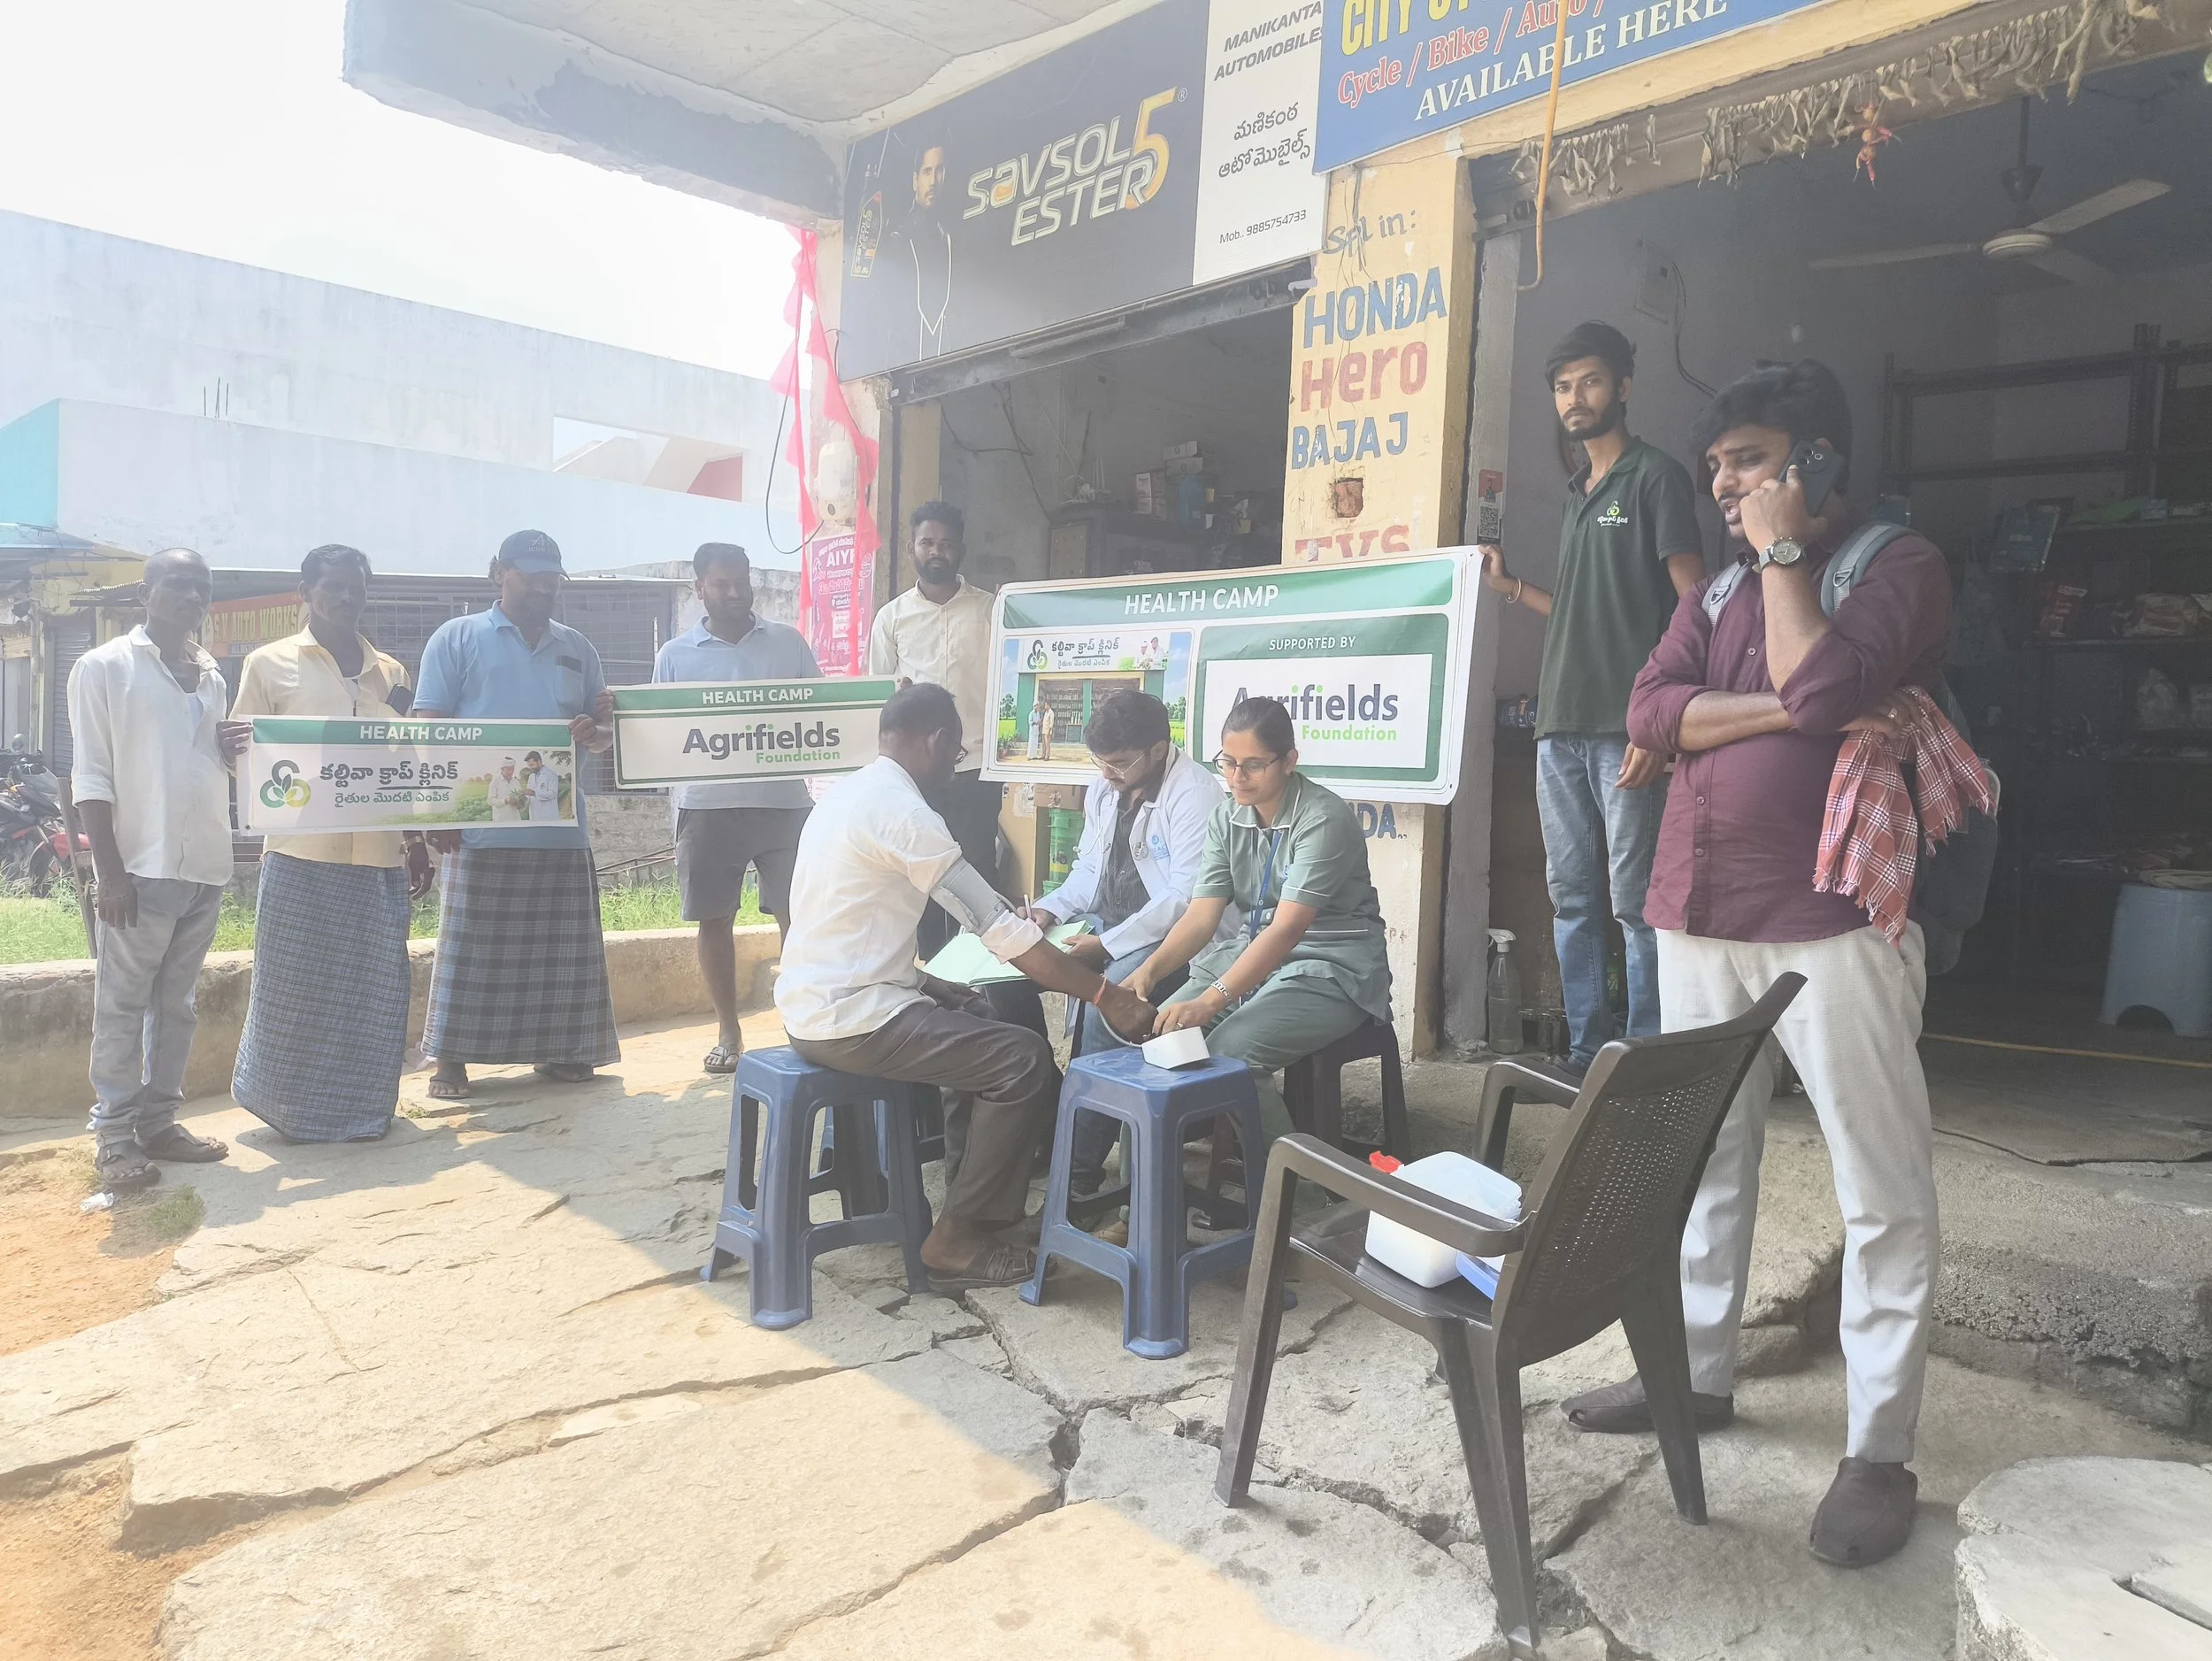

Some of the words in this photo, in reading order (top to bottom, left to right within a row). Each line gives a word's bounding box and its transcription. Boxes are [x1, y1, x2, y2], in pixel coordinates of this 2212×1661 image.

[1225, 1, 1322, 52] MANIKANTA
[1338, 57, 1402, 108] Cycle
[1427, 27, 1489, 71] Bike
[1415, 23, 1607, 120] AVAILABLE
[1617, 0, 1726, 49] HERE
[1234, 103, 1298, 140] మణికంఠ
[1218, 128, 1310, 177] ఆటోమొబైల్స్
[1011, 156, 1155, 246] ESTER
[1246, 210, 1307, 236] 9885754733
[1303, 266, 1447, 349] HONDA
[1301, 342, 1428, 412] Hero
[1292, 411, 1409, 469] BAJAJ
[1125, 589, 1206, 615] HEALTH
[1213, 585, 1279, 611] CAMP
[232, 610, 255, 642] AUTO
[259, 604, 298, 640] WORKS
[1268, 636, 1336, 651] SUPPORTED
[1340, 635, 1356, 649] BY
[702, 689, 764, 704] HEALTH
[768, 688, 814, 701] CAMP
[359, 725, 430, 741] HEALTH
[434, 727, 483, 741] CAMP
[682, 721, 841, 760] Agrifields
[1302, 724, 1398, 742] Foundation
[319, 762, 374, 788] కల్టివా
[756, 749, 841, 764] Foundation
